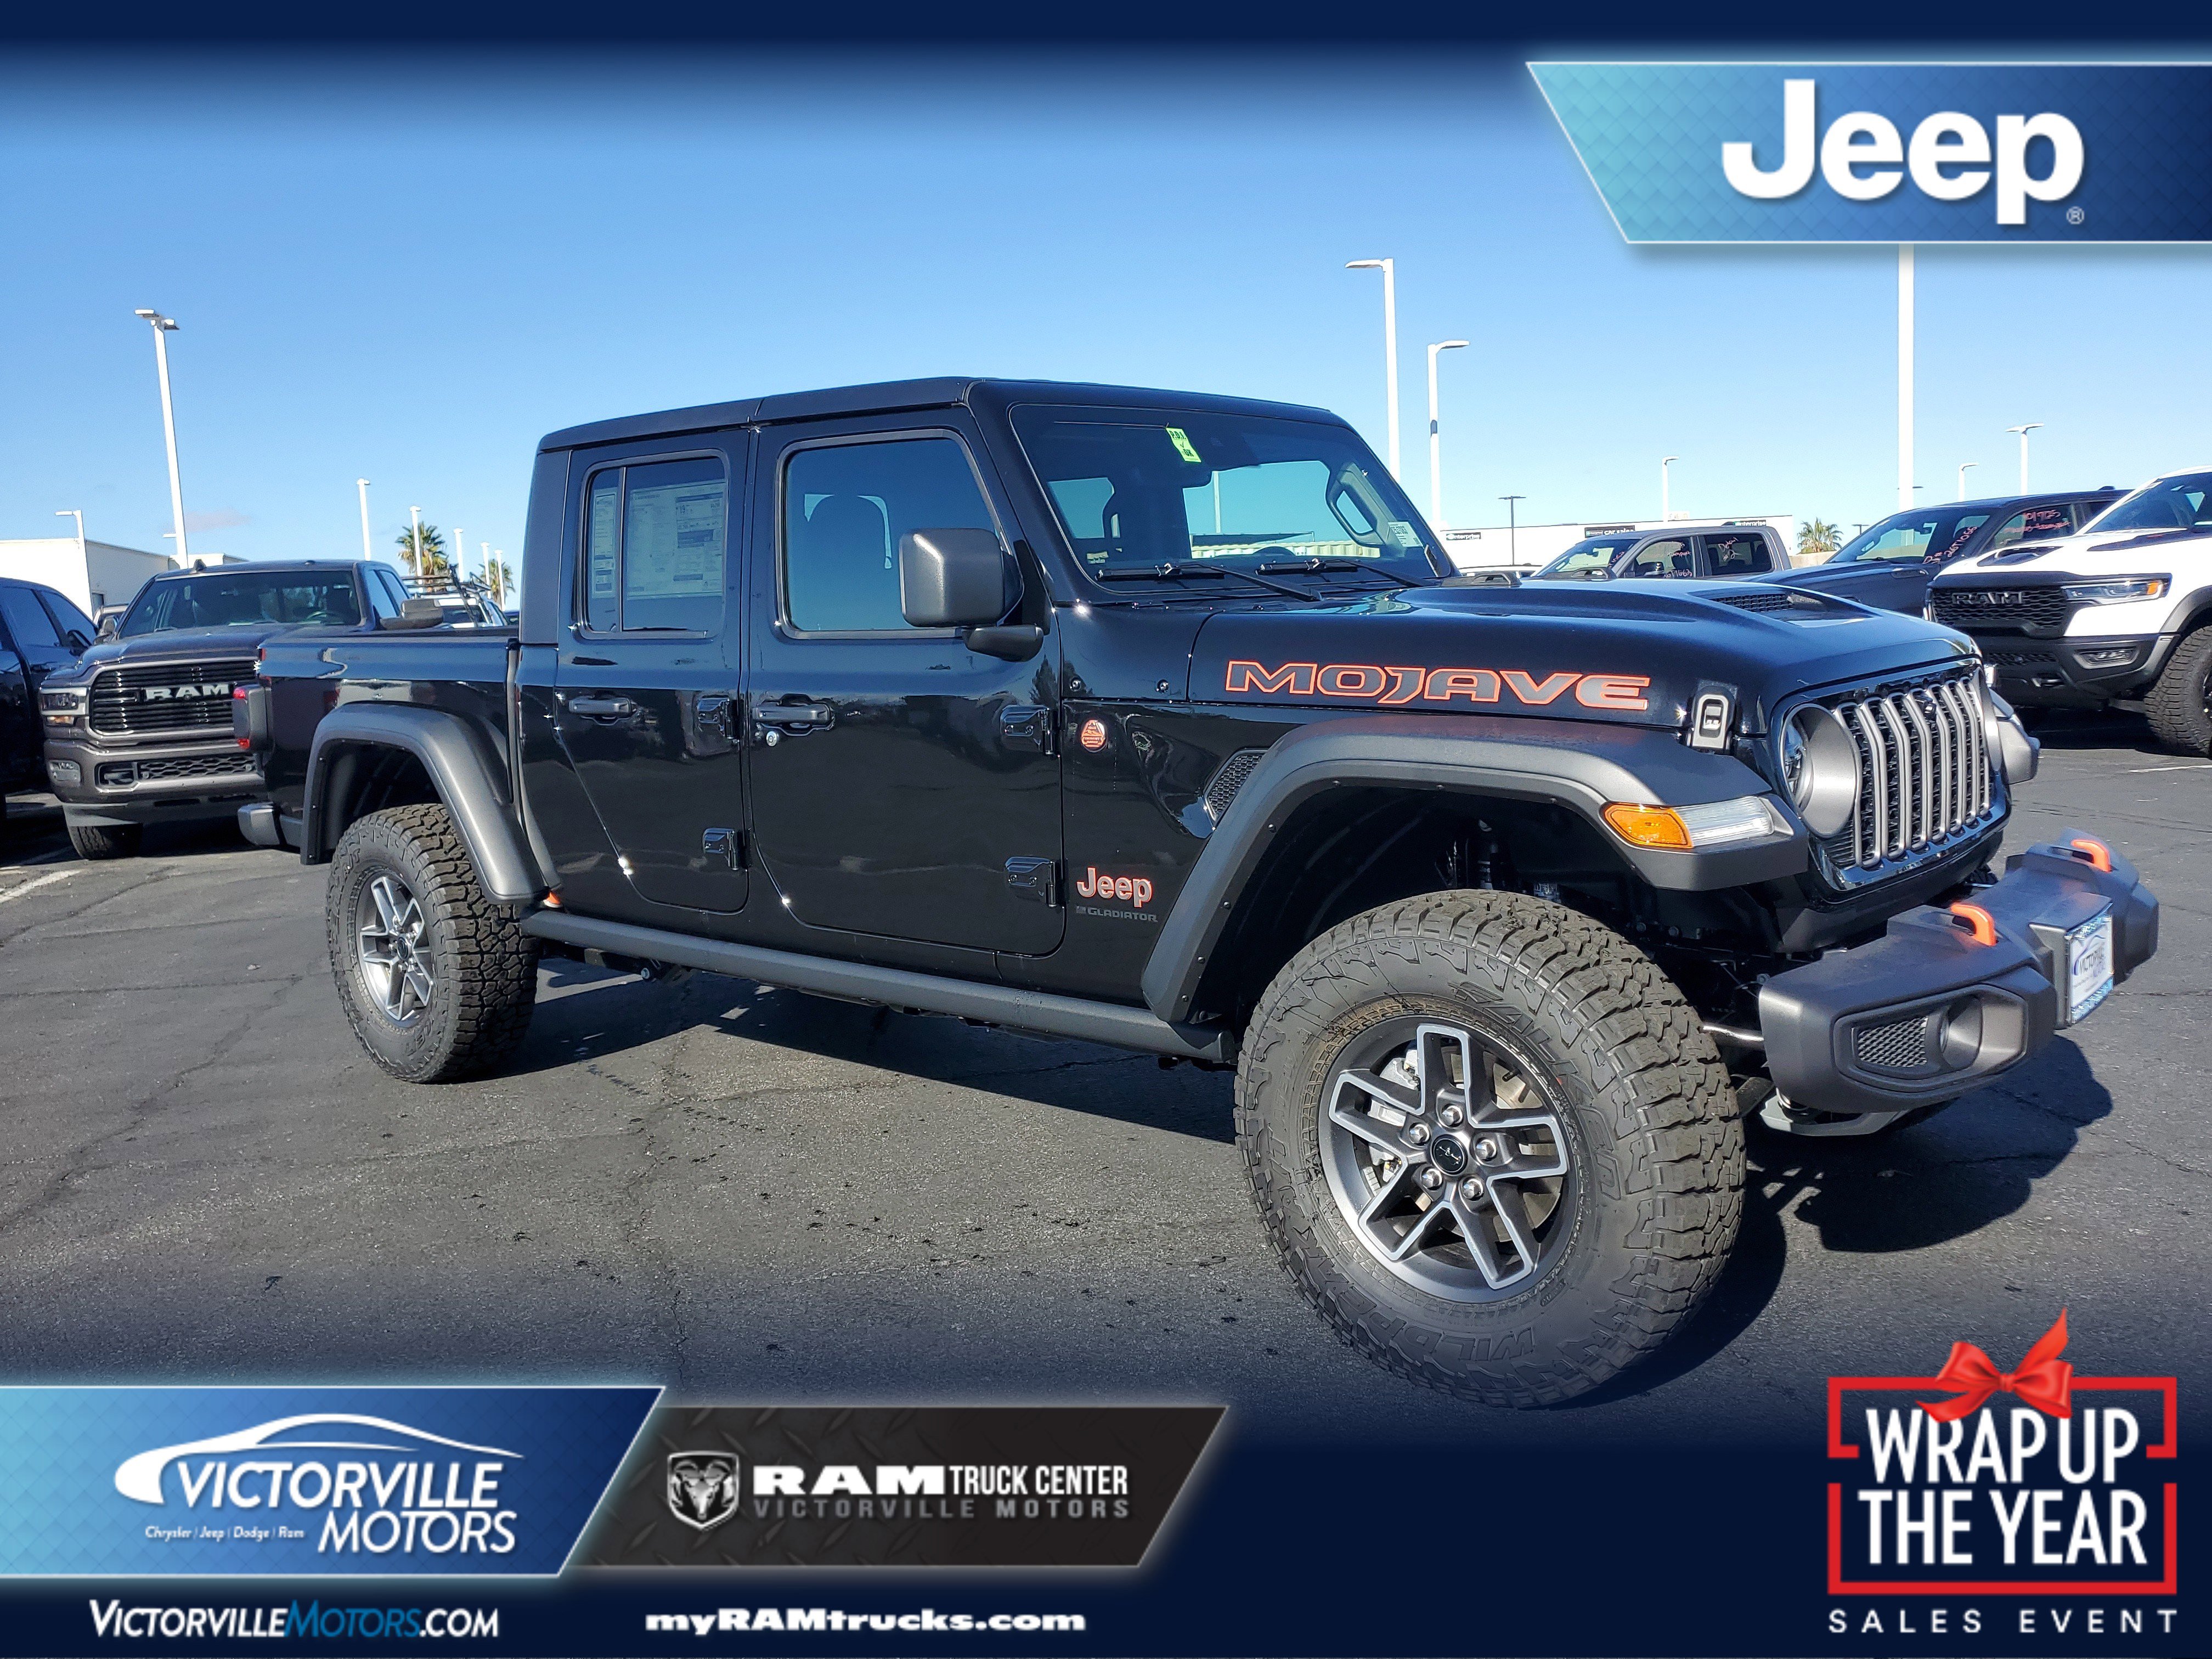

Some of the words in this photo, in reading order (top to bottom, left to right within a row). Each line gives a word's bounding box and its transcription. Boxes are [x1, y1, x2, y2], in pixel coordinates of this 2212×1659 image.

[1951, 591, 2022, 604] RAM
[145, 683, 230, 701] RAM
[1225, 660, 1651, 710] MOJAVE
[1076, 866, 1152, 908] Jeep
[1087, 907, 1158, 923] GLADIATOR
